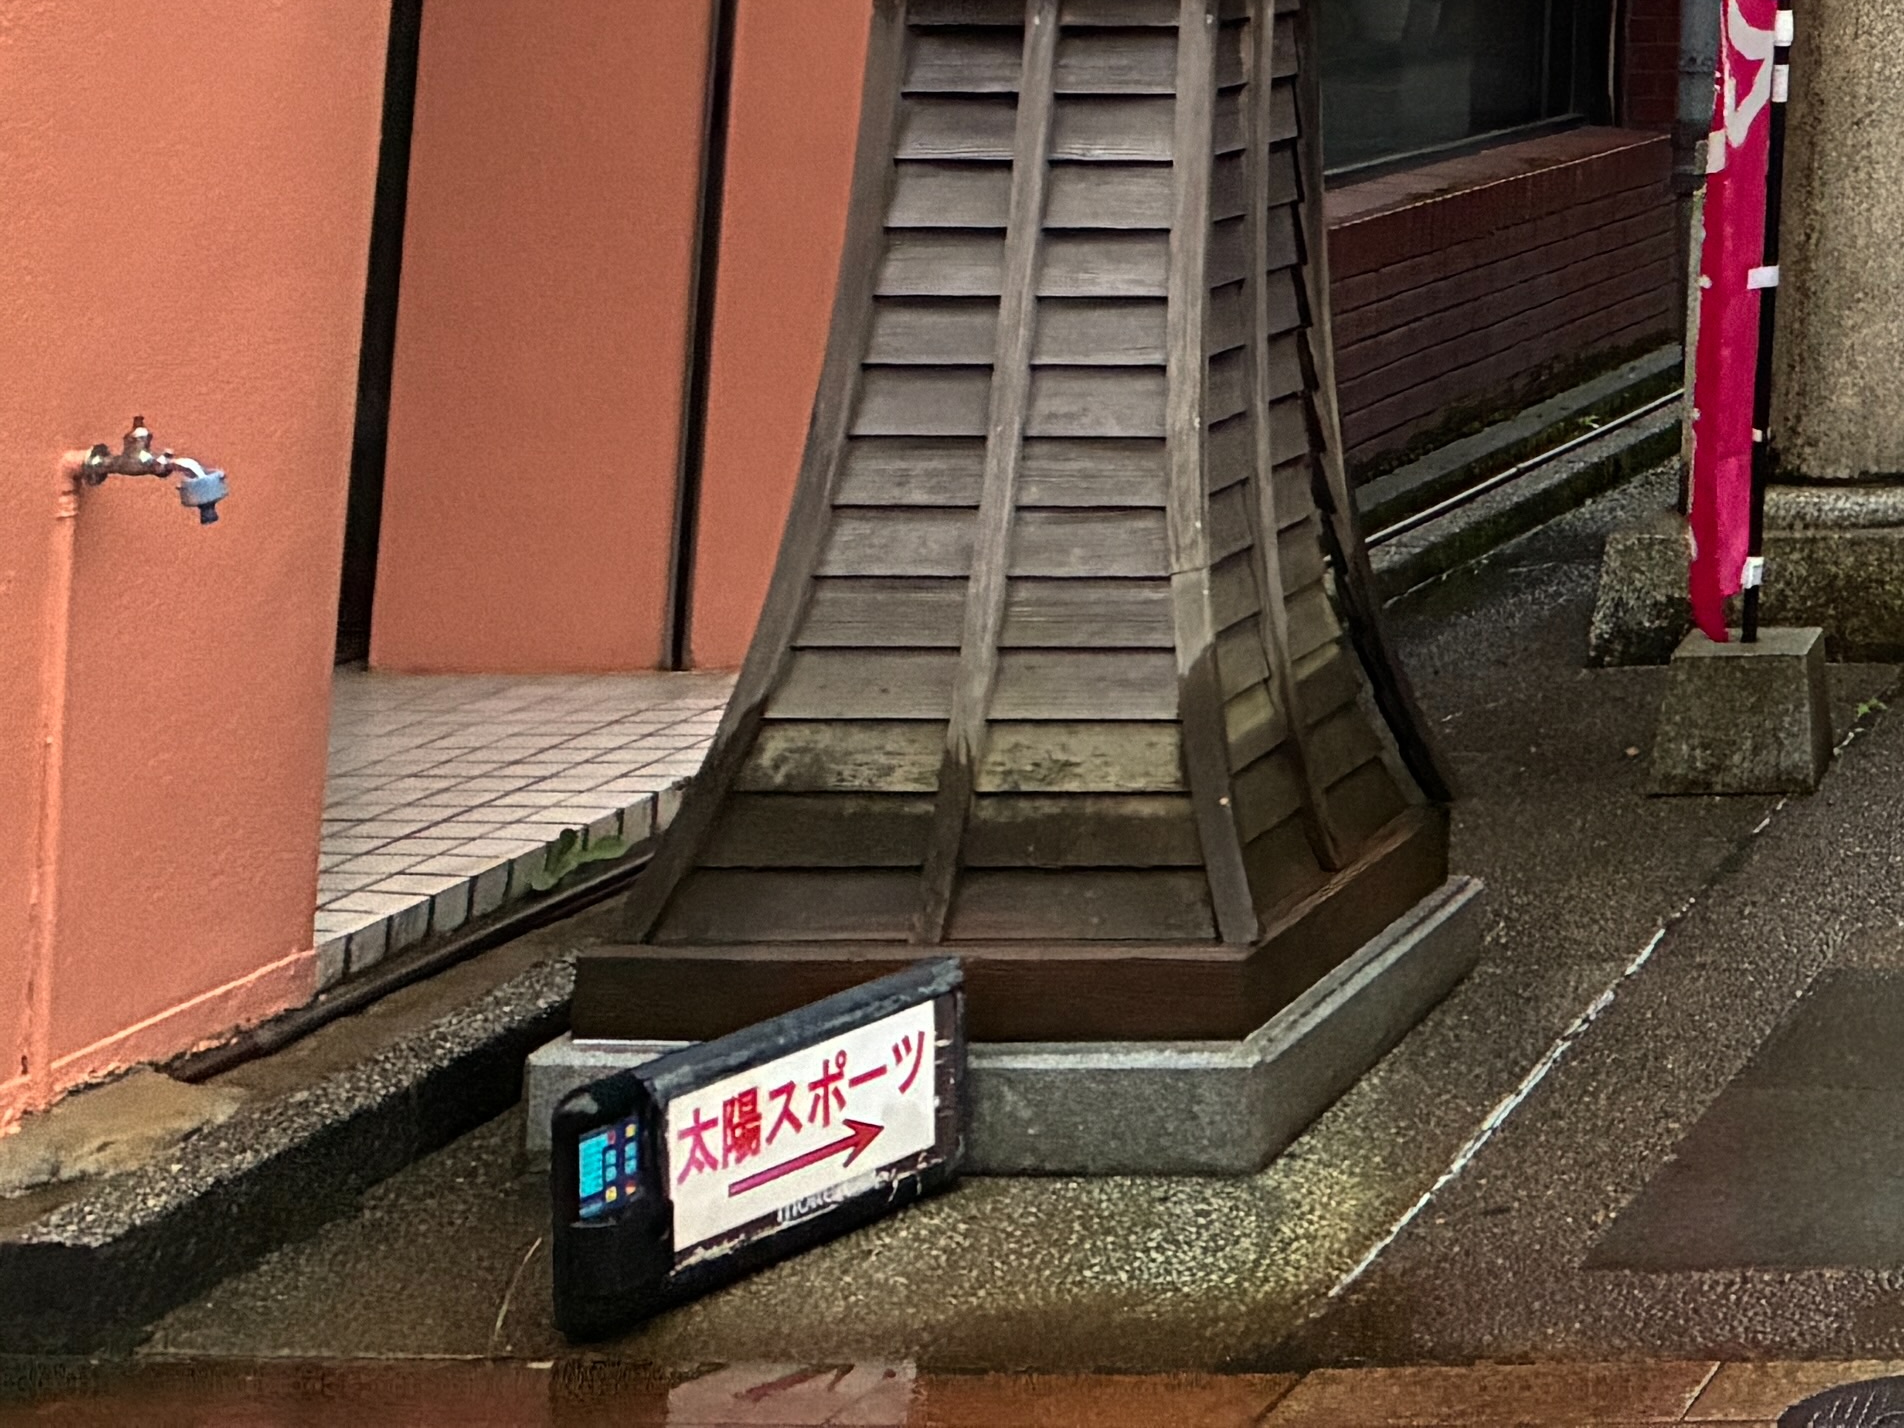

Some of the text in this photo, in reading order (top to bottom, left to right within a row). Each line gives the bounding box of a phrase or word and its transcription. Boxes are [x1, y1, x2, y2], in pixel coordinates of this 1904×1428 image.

[677, 1030, 926, 1186] 太陽スポーツ
